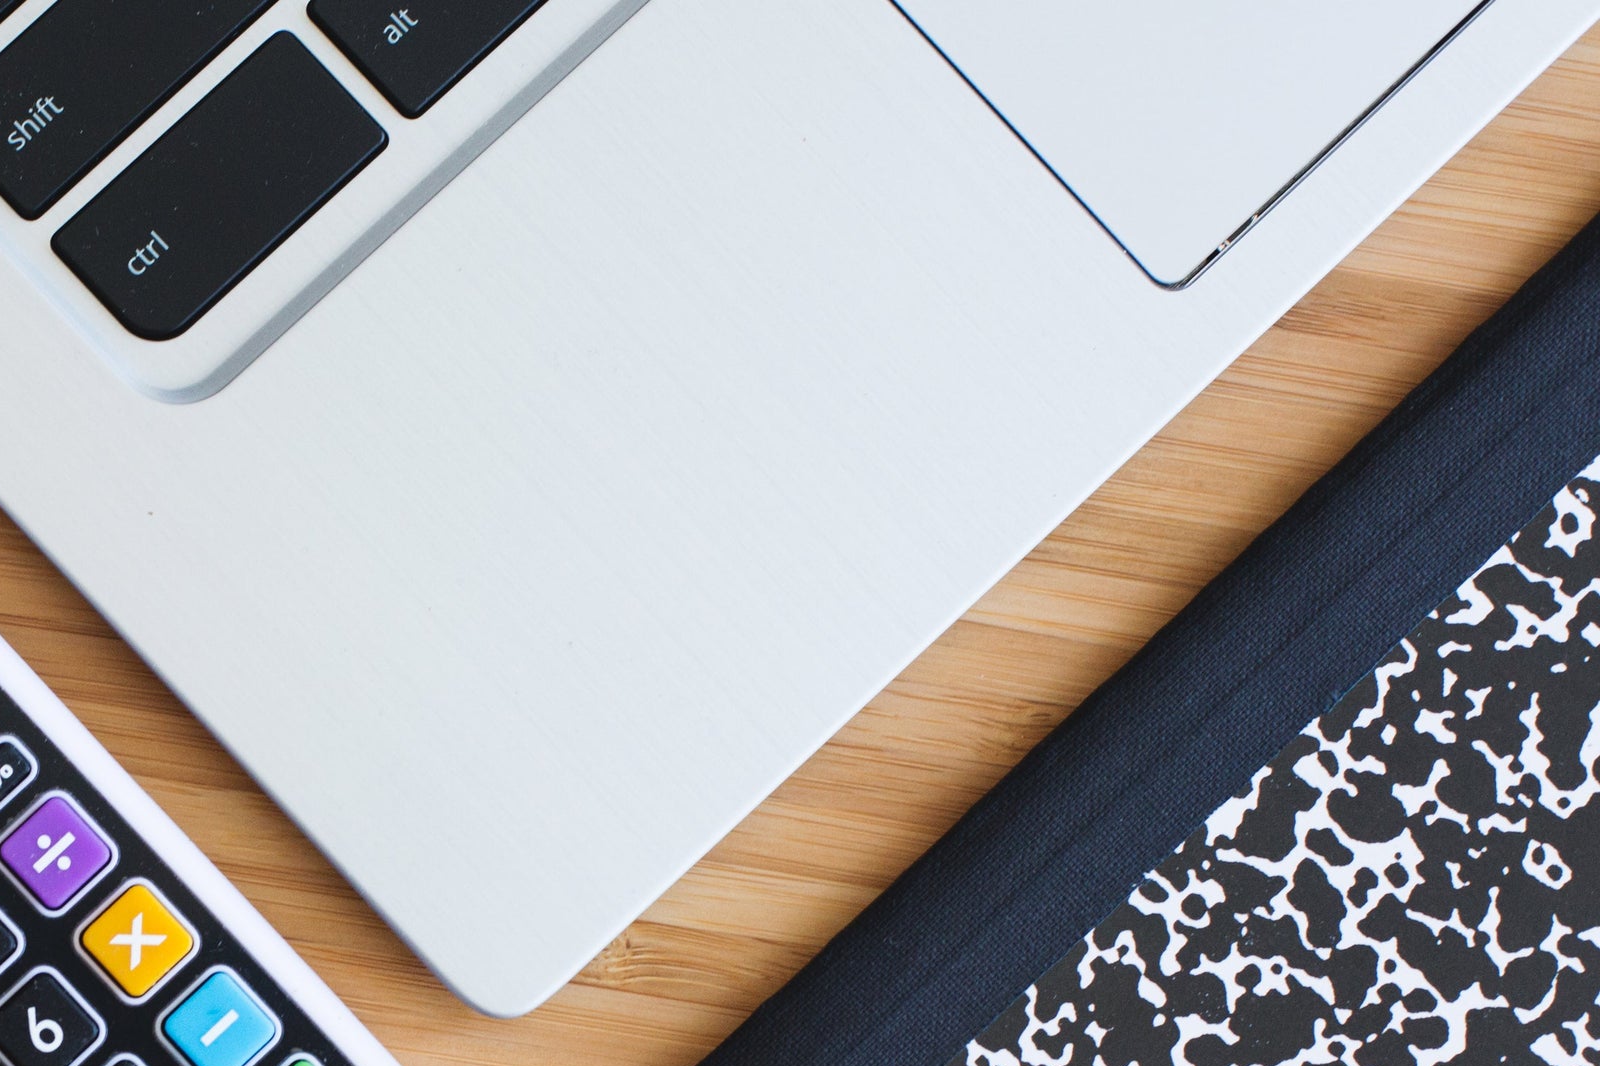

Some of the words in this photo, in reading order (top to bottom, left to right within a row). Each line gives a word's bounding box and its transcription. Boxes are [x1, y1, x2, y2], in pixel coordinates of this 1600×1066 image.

[383, 9, 419, 45] alt
[7, 96, 64, 151] shift
[127, 230, 169, 276] ctrl
[27, 1006, 64, 1053] 6
